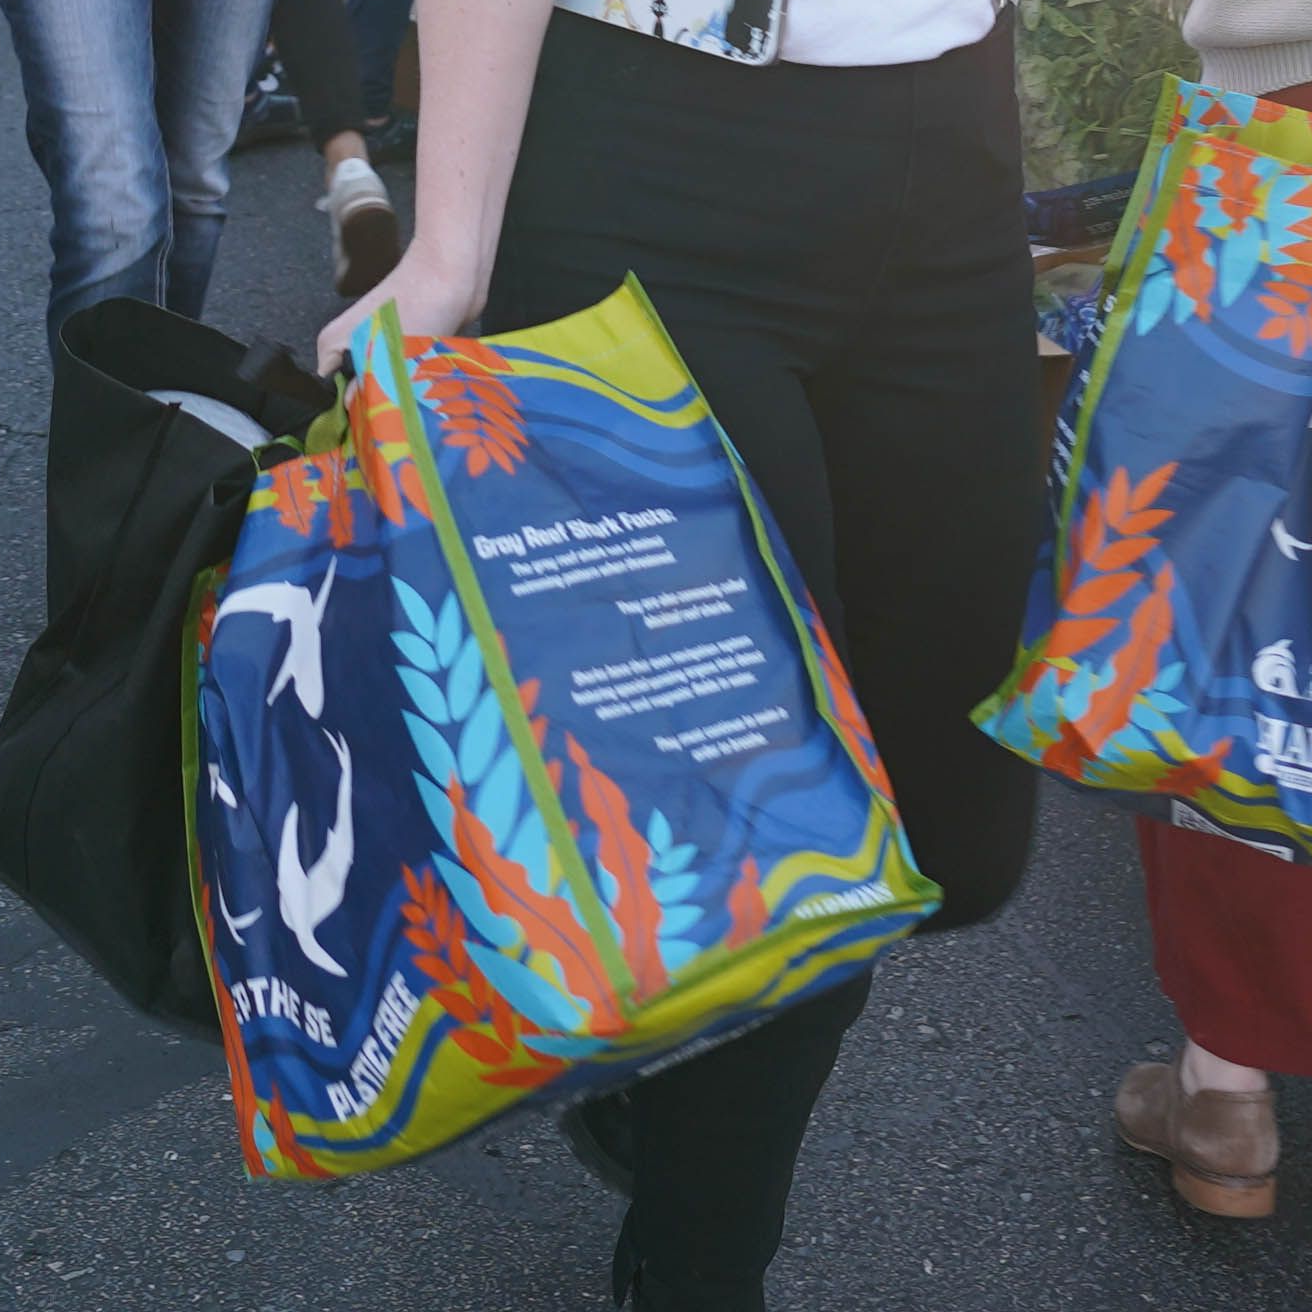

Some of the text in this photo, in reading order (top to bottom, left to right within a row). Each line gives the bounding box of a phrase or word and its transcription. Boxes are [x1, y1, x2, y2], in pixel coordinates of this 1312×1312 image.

[521, 520, 570, 549] Reef
[565, 515, 625, 540] Shark
[246, 975, 303, 1031] THE
[303, 999, 338, 1049] SE
[372, 970, 421, 1057] FREE
